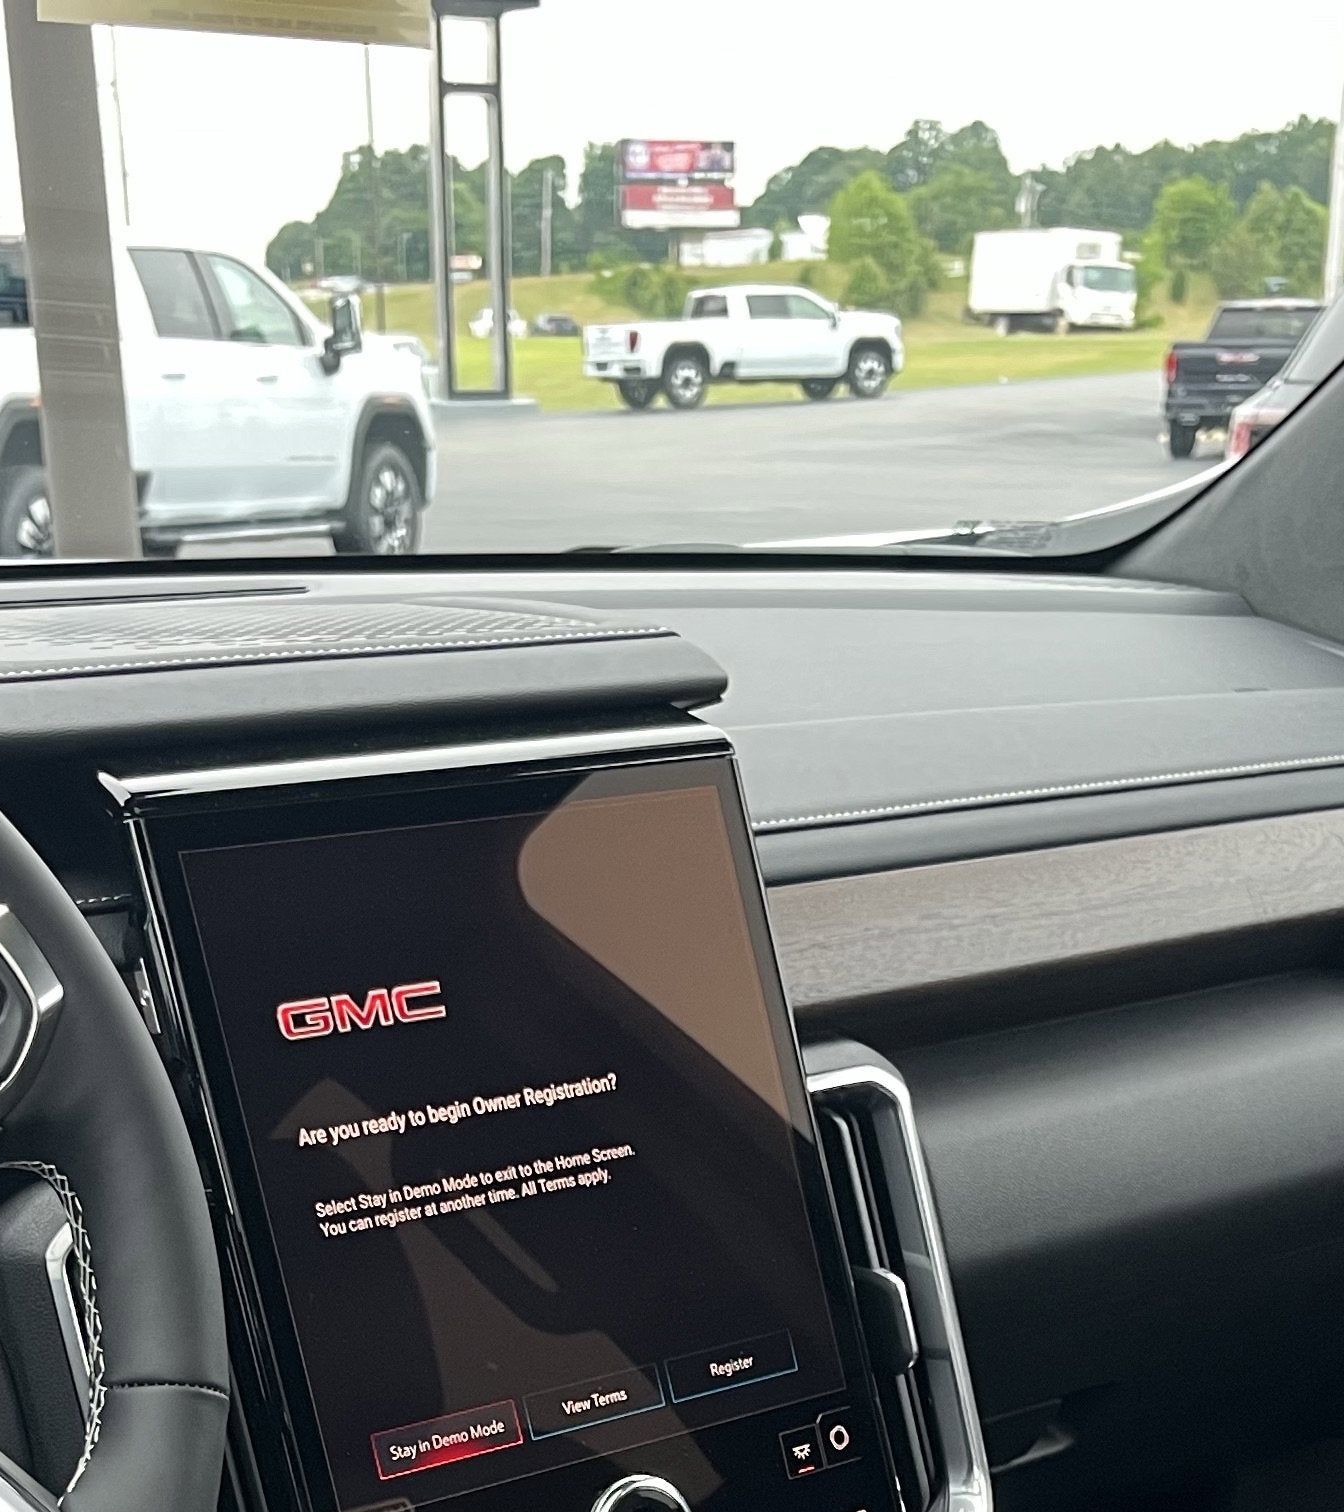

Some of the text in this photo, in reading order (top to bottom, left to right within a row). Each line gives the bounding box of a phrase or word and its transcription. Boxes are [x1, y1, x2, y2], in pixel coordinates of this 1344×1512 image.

[276, 980, 446, 1041] GMC
[298, 1073, 617, 1147] Are you ready to begin Owner Registration?
[315, 1143, 636, 1218] Select Stay in Demo Mode to exit to the Home Screen.
[319, 1166, 612, 1238] You can register at another time. All Terms apply.
[709, 1354, 755, 1377] Register
[561, 1388, 629, 1416] View Terms
[389, 1419, 506, 1462] Stay in Demo Mode
